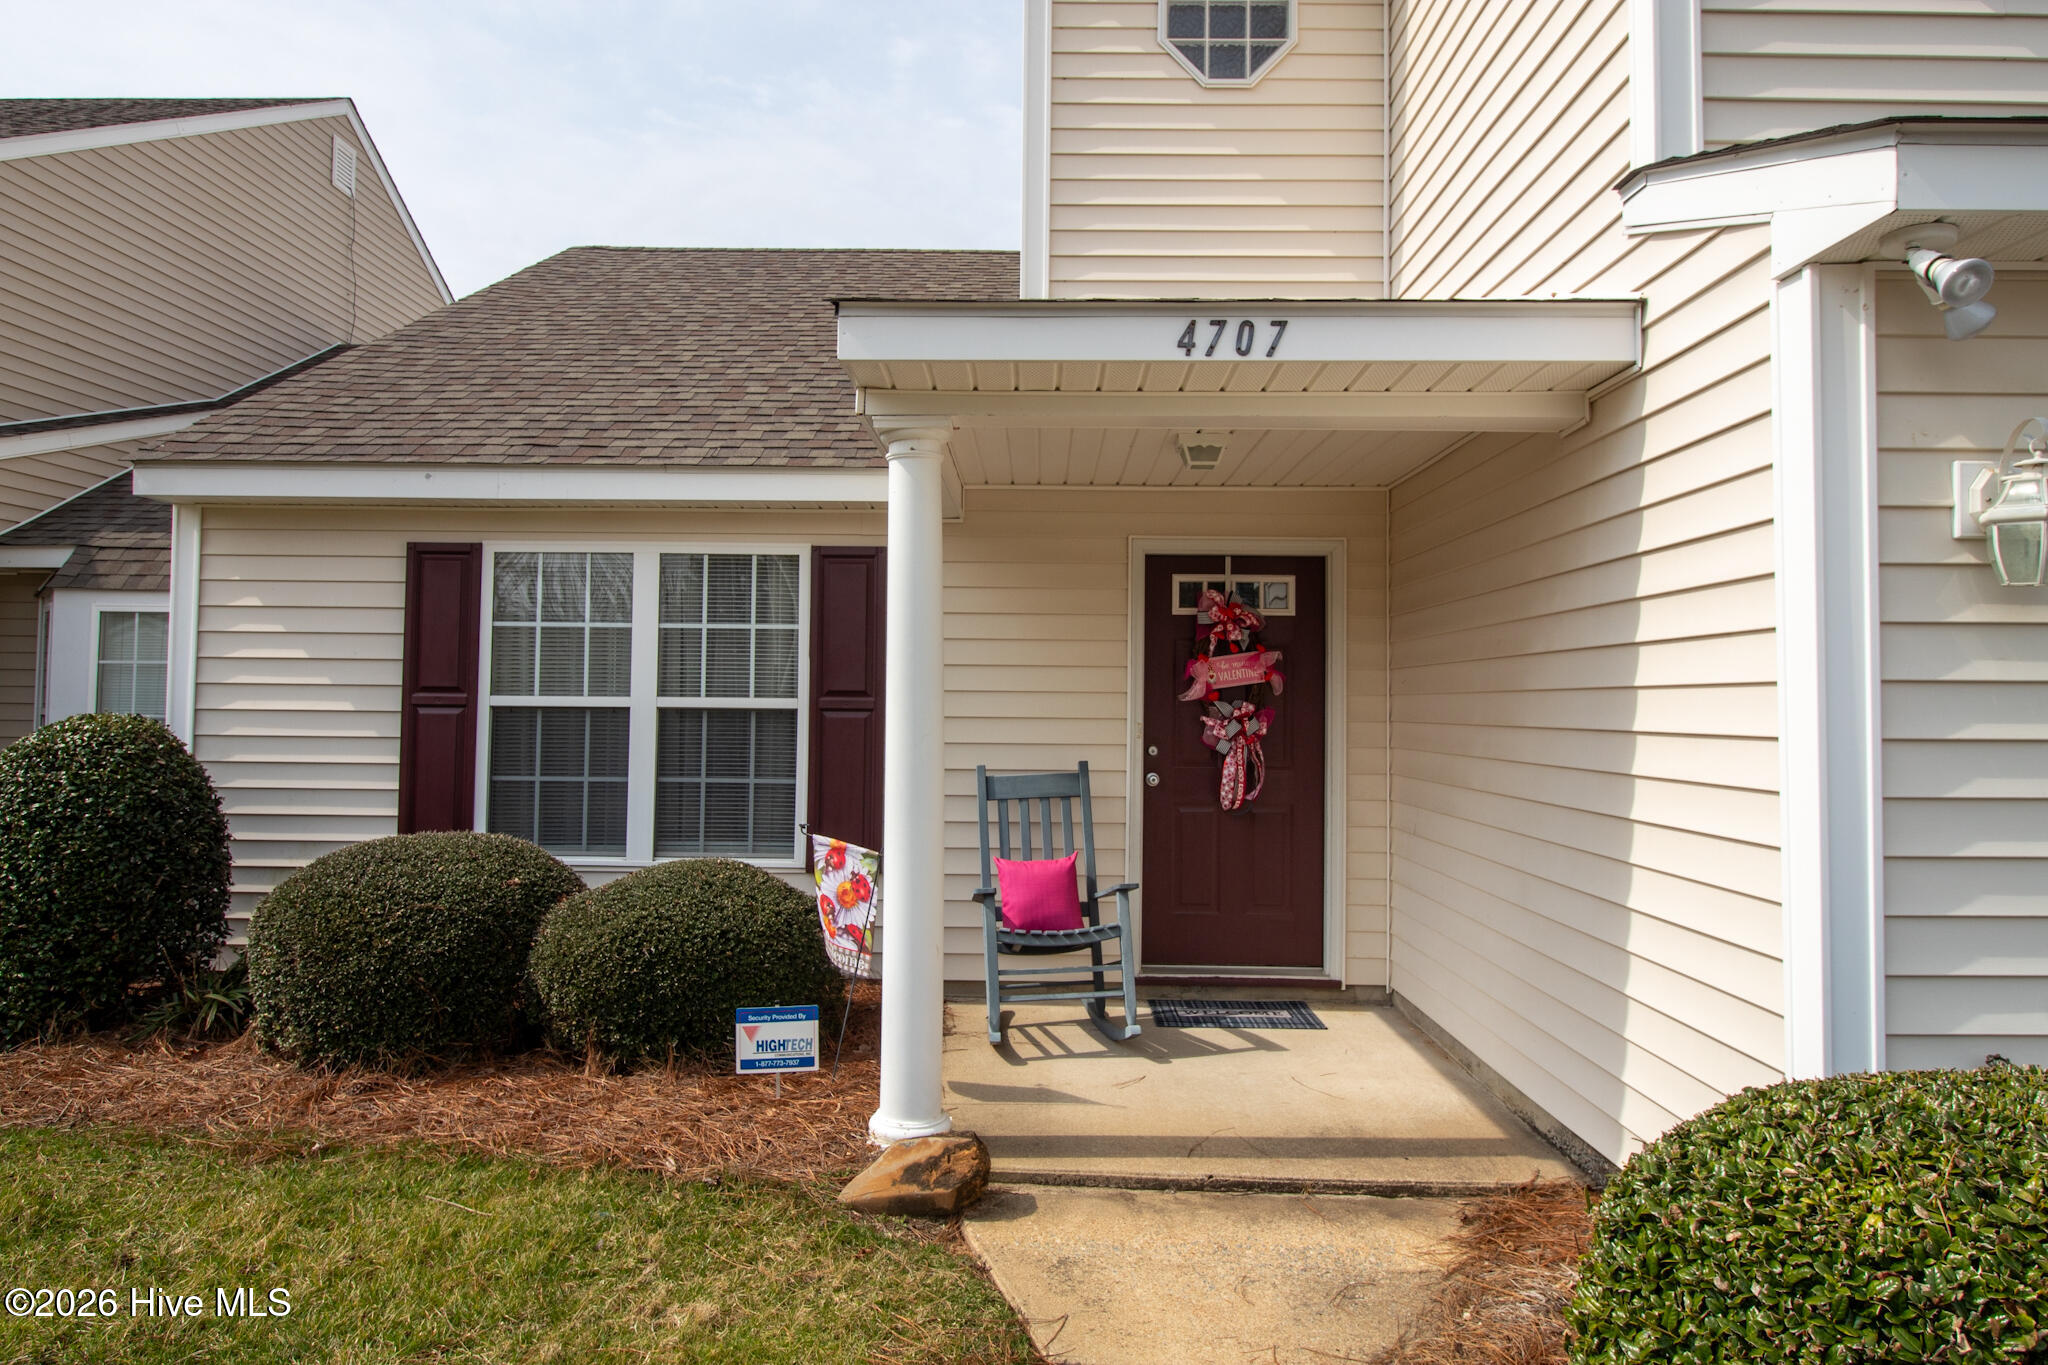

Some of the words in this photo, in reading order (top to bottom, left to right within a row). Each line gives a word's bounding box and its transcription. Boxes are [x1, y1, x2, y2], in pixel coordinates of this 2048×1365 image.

[1177, 319, 1288, 357] 4707
[1217, 668, 1259, 681] VALENTINE
[748, 1014, 771, 1022] Security
[798, 1012, 806, 1020] By
[756, 1037, 813, 1052] HIGHTECH
